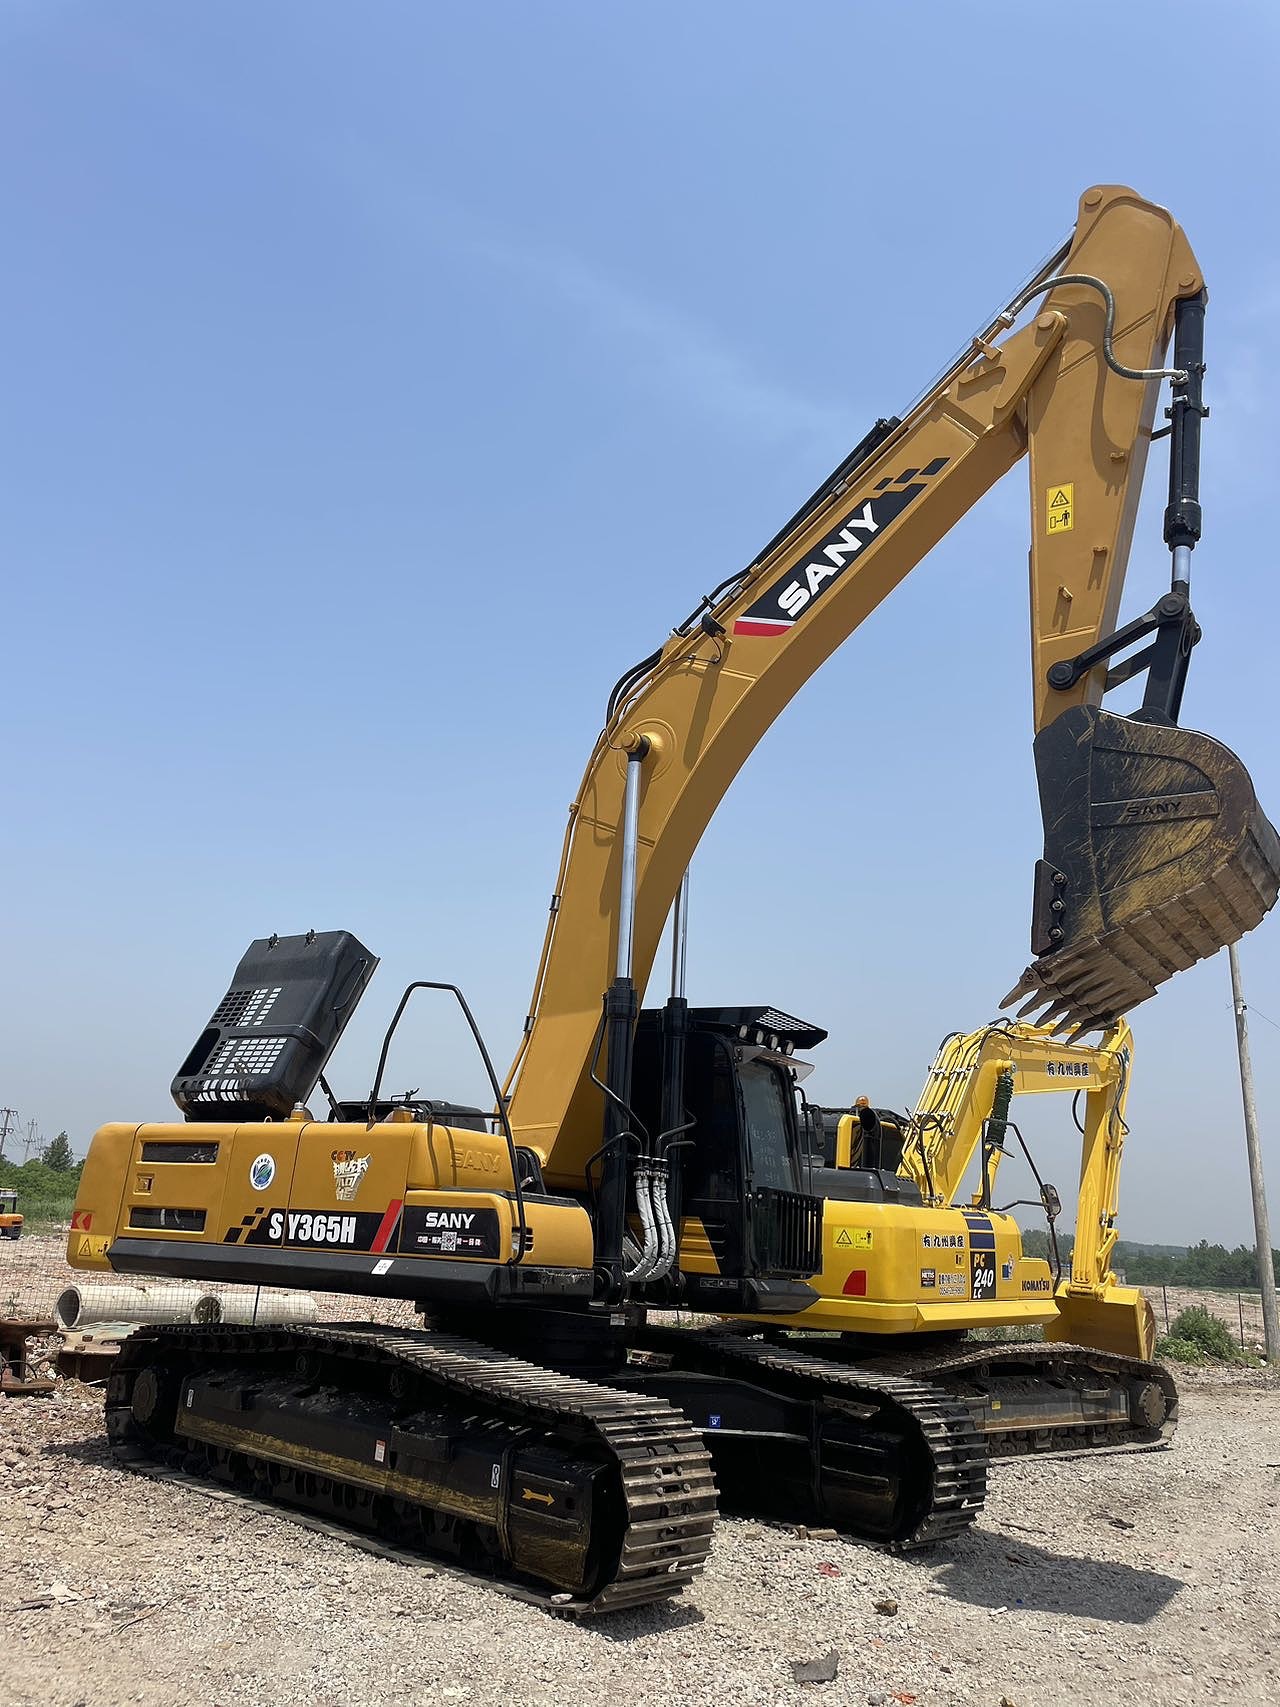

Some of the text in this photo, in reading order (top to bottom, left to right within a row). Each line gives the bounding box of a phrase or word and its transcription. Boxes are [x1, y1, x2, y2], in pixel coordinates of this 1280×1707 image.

[777, 501, 880, 618] SANY
[1126, 802, 1181, 817] SANY
[450, 1148, 500, 1173] SANY
[268, 1212, 357, 1244] SY365H
[425, 1212, 475, 1229] SANY
[973, 1253, 986, 1268] PC
[973, 1268, 994, 1288] 240
[1021, 1277, 1050, 1291] KOMATSU
[972, 1288, 983, 1299] LC
